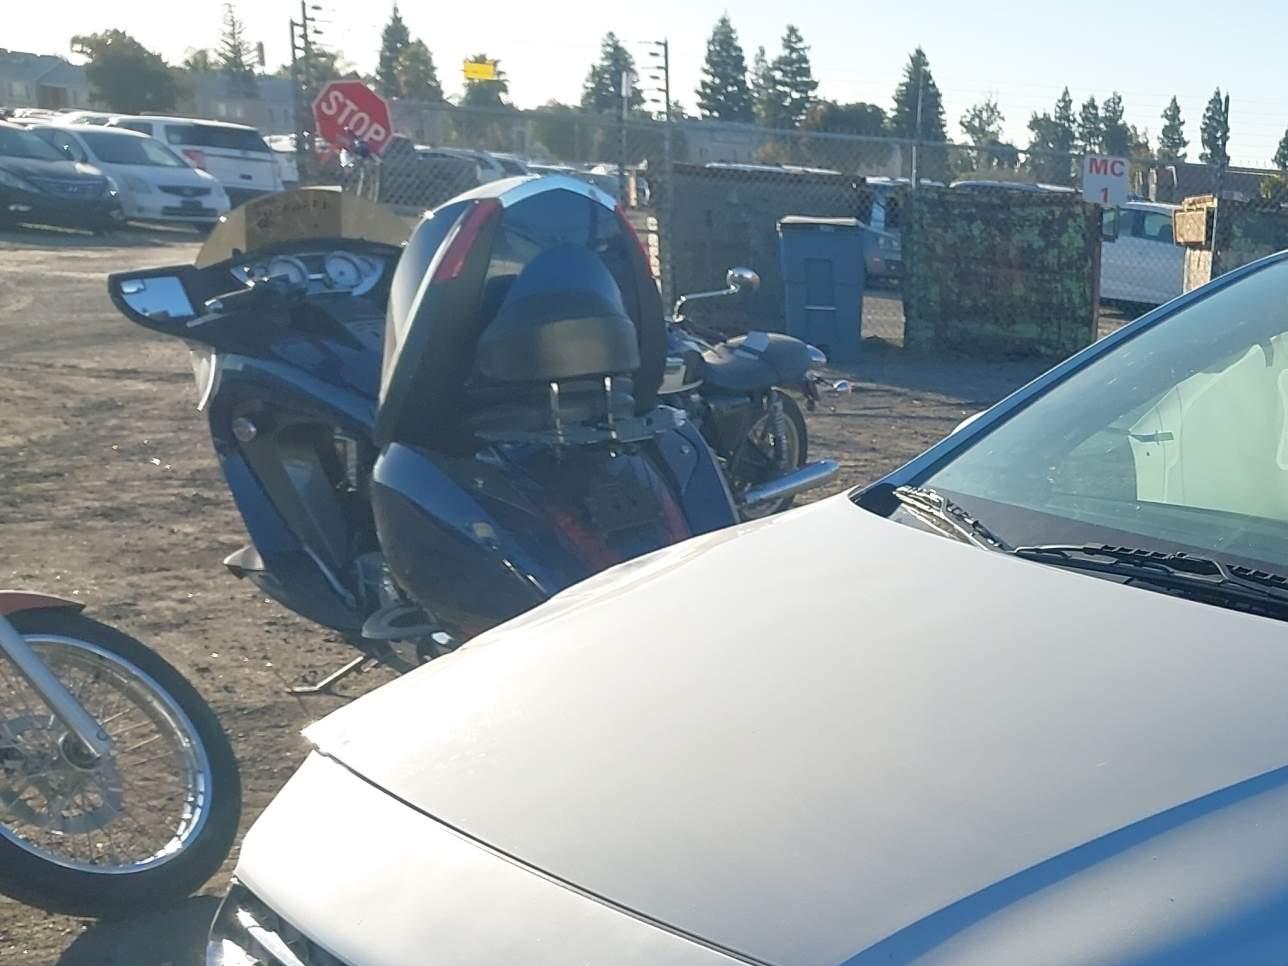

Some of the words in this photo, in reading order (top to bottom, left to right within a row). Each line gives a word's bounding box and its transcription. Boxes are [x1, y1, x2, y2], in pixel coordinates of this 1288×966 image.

[321, 90, 386, 142] STOP
[1089, 157, 1125, 177] MC
[1101, 187, 1108, 203] 1
